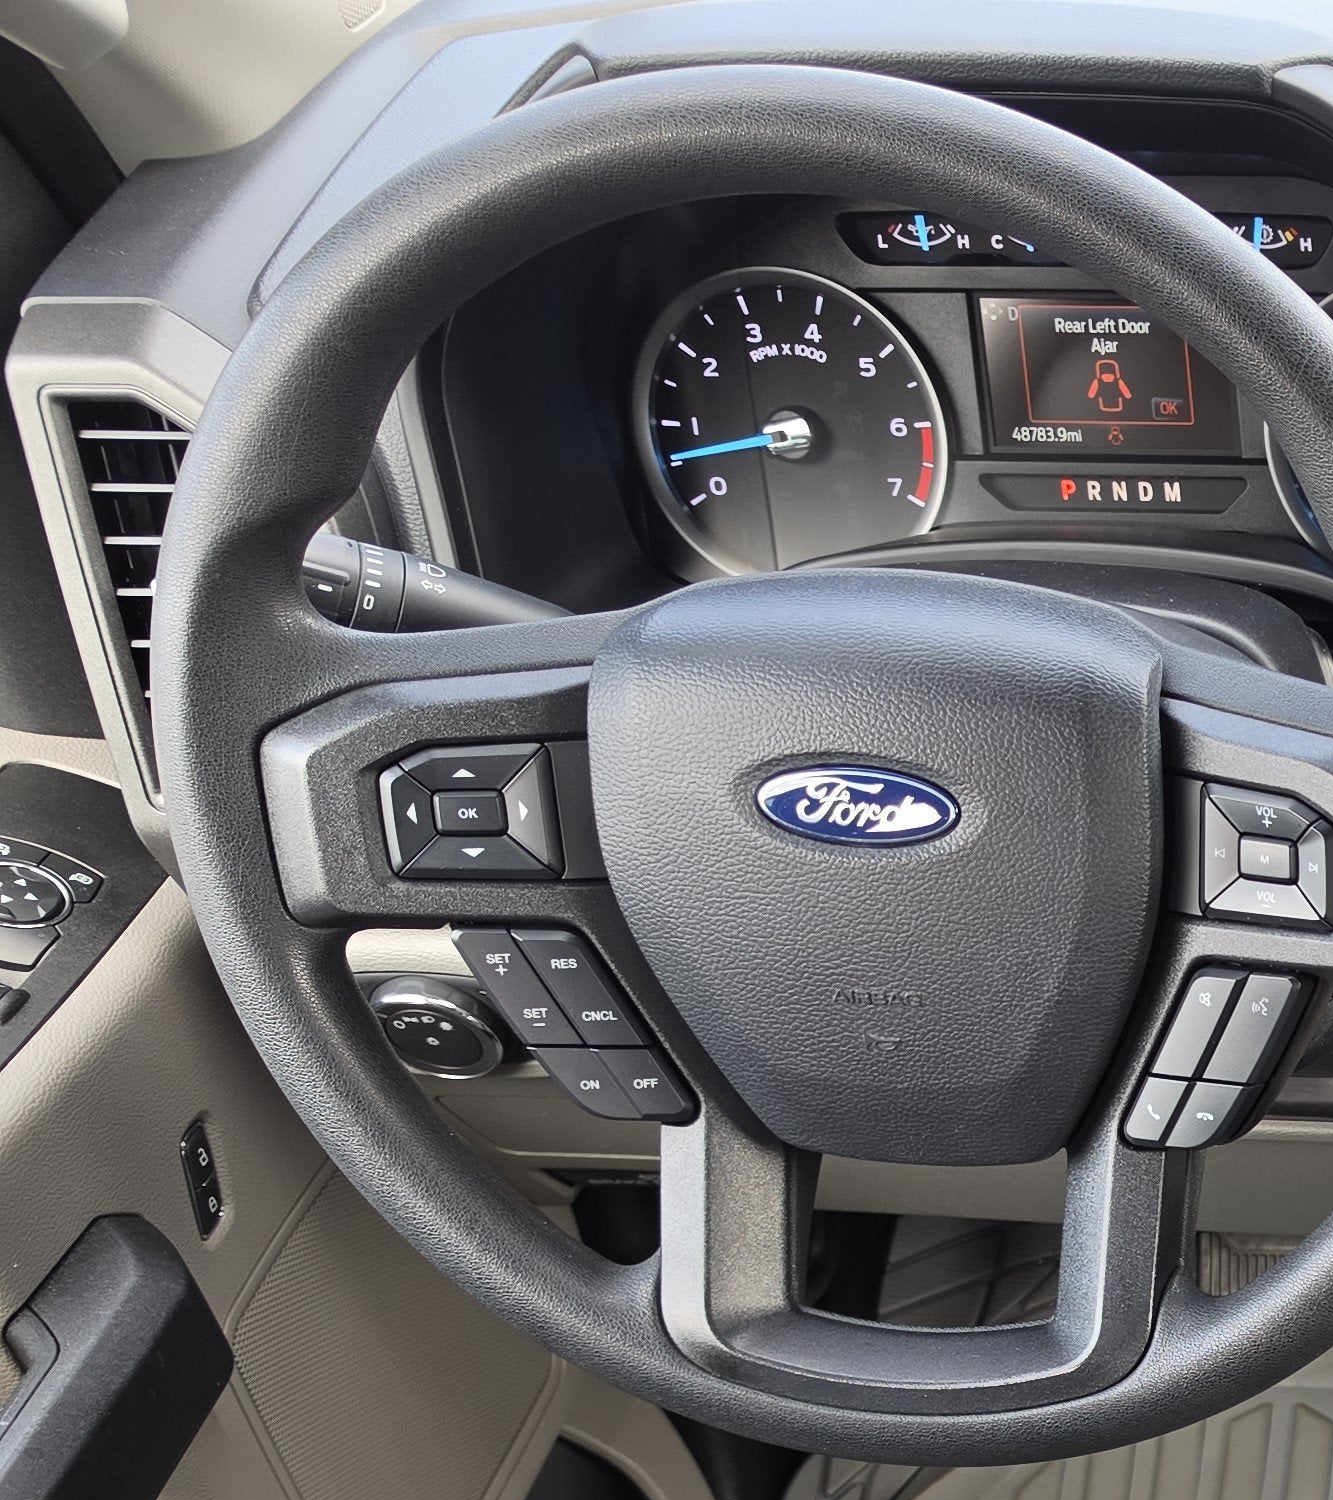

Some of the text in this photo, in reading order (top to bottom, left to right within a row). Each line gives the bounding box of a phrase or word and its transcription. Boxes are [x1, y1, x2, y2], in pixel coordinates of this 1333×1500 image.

[877, 234, 889, 248] L
[957, 234, 970, 249] H
[990, 234, 1004, 249] C
[1299, 237, 1313, 252] H
[745, 323, 762, 343] 3
[804, 323, 823, 343] 4
[1054, 318, 1151, 334] Rear Left Door
[749, 343, 827, 363] RPM X 1000
[1091, 338, 1118, 355] Ajar
[703, 358, 719, 377] 2
[859, 359, 876, 377] 5
[1159, 401, 1179, 415] OK
[692, 417, 699, 435] 1
[890, 418, 908, 436] 6
[709, 477, 727, 496] 0
[887, 478, 903, 496] 7
[1060, 479, 1182, 502] P R N D M
[796, 776, 932, 834] Ford
[1256, 806, 1277, 819] VOL
[458, 808, 478, 820] OK
[1260, 854, 1269, 865] M
[1256, 891, 1277, 903] VOL
[486, 953, 511, 965] SET
[550, 958, 578, 970] RES
[523, 1007, 548, 1019] SET
[581, 1010, 618, 1022] CNCL
[580, 1079, 601, 1090] ON
[633, 1078, 659, 1090] OFF
